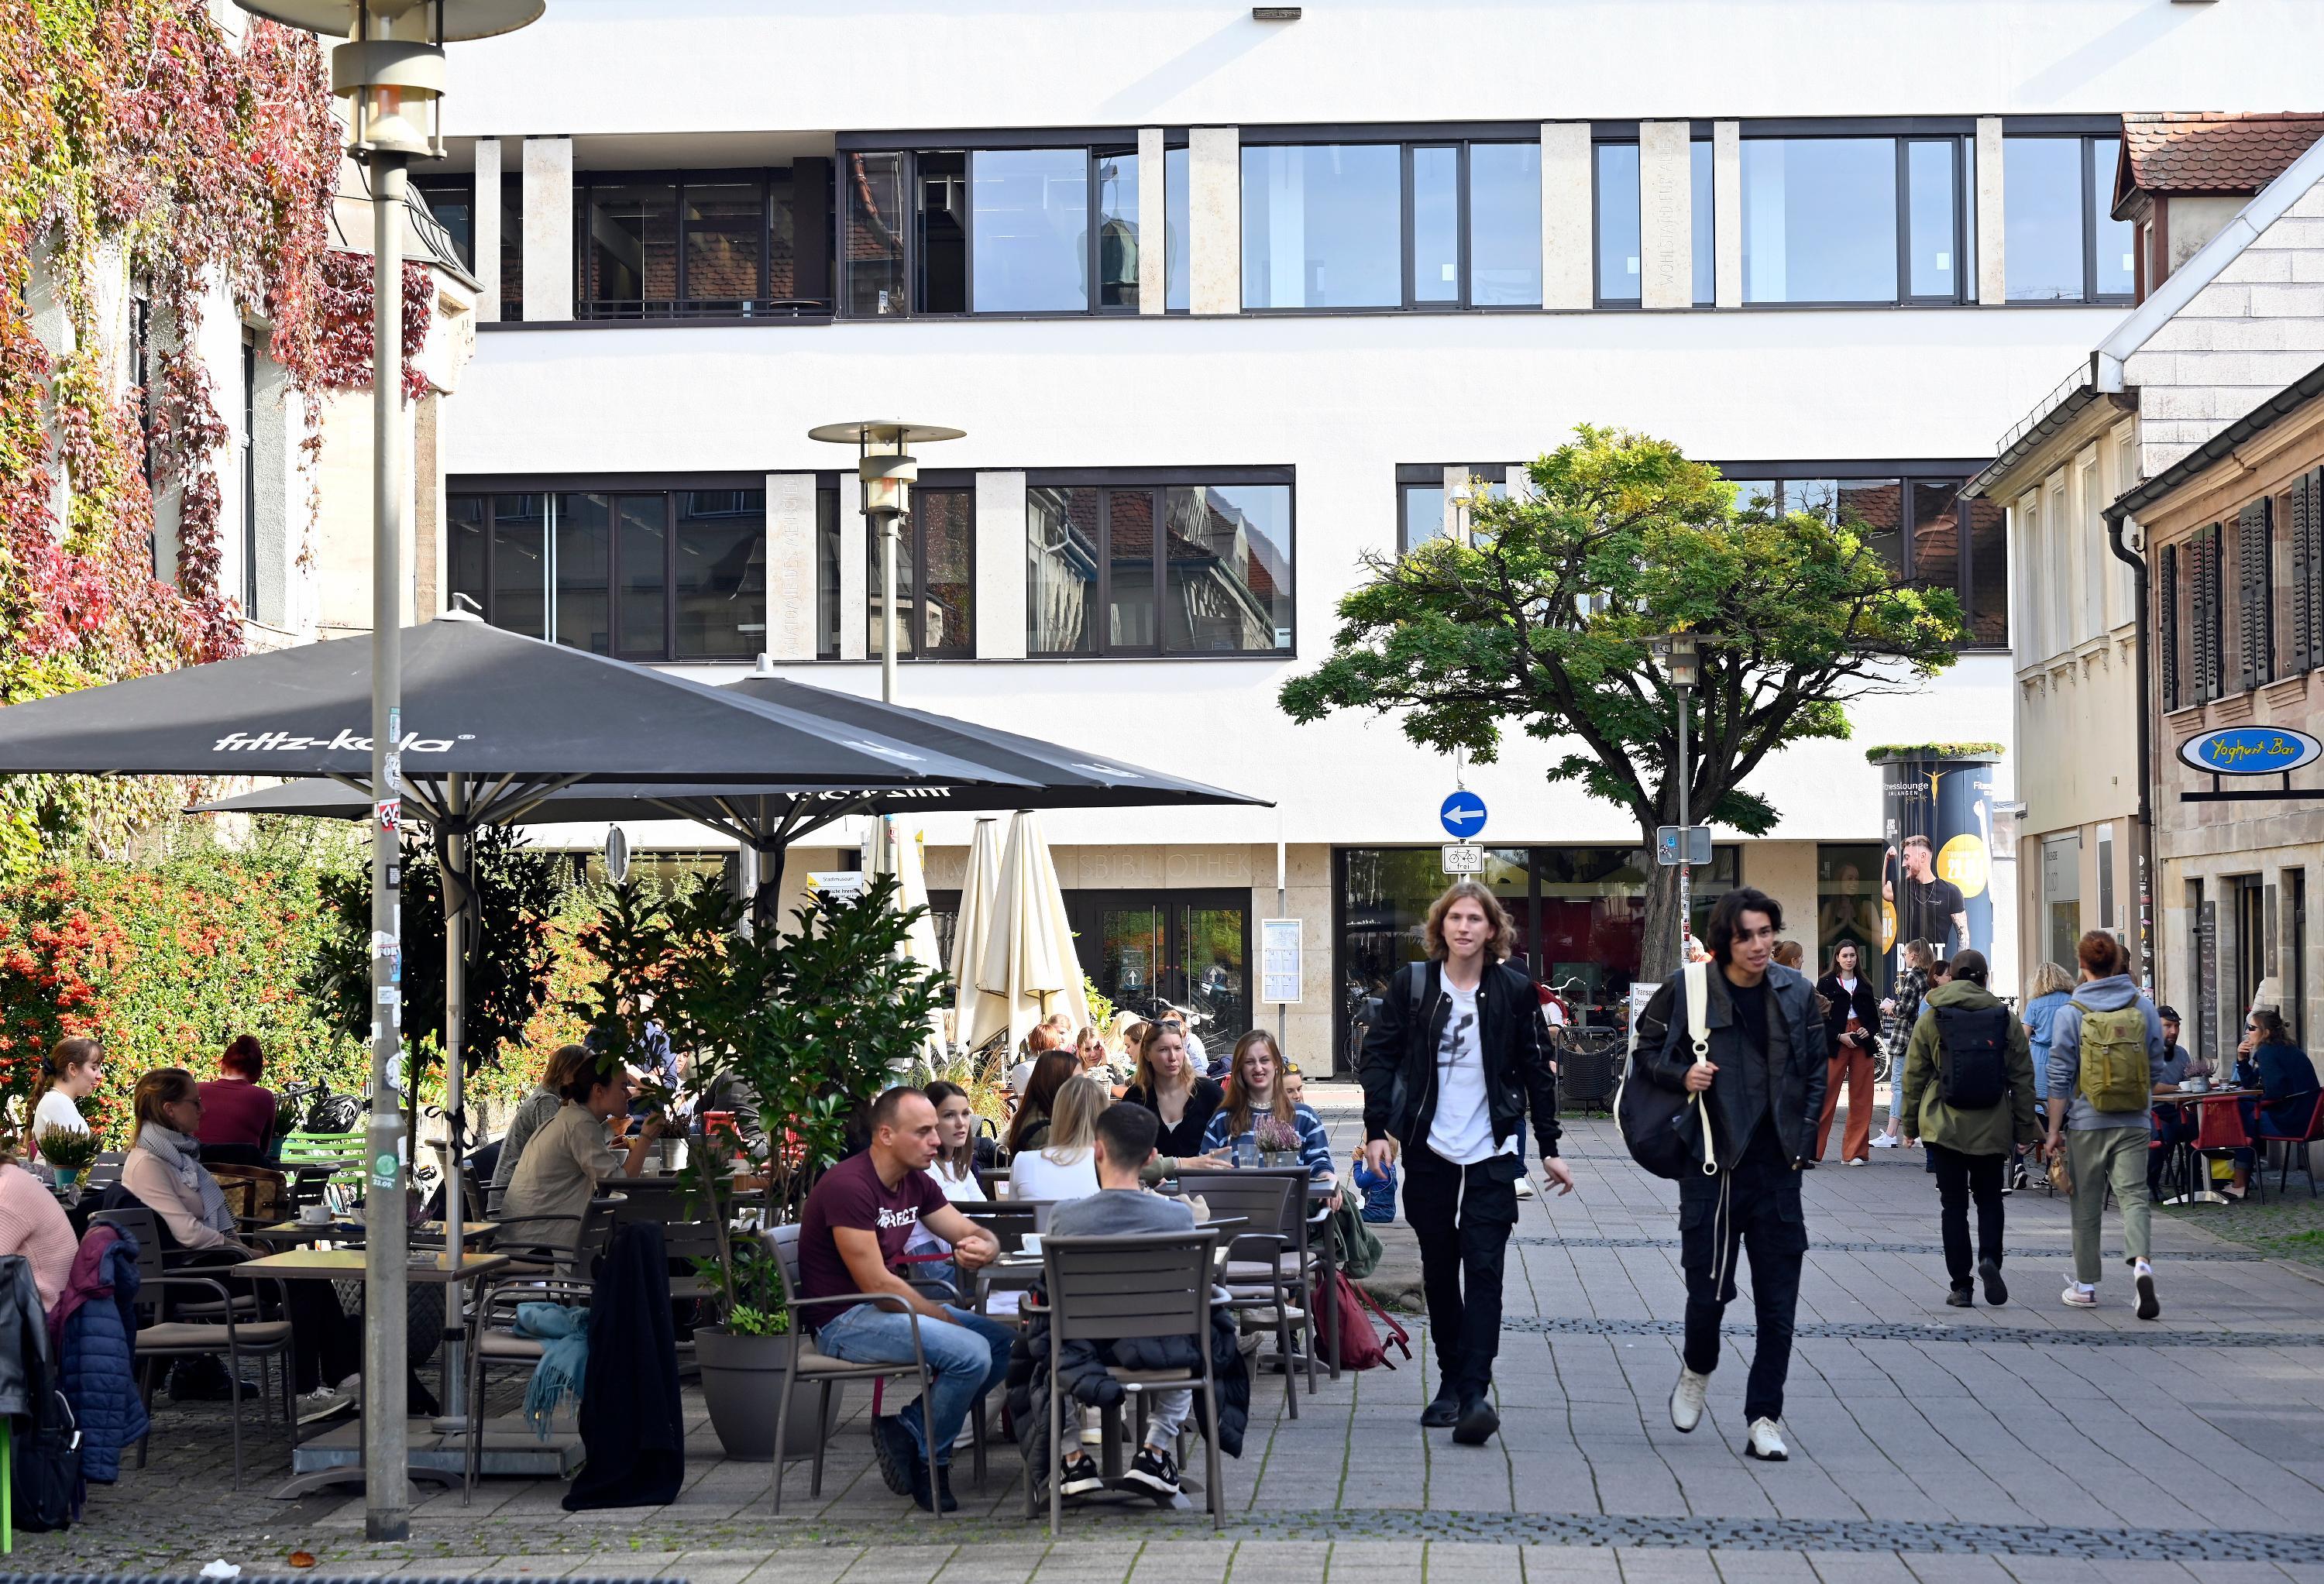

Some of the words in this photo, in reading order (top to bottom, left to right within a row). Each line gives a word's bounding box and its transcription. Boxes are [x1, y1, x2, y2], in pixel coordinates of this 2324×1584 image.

[1658, 143, 1673, 172] ALLE
[2212, 738, 2265, 764] Yoghurt
[2267, 737, 2295, 755] Bar
